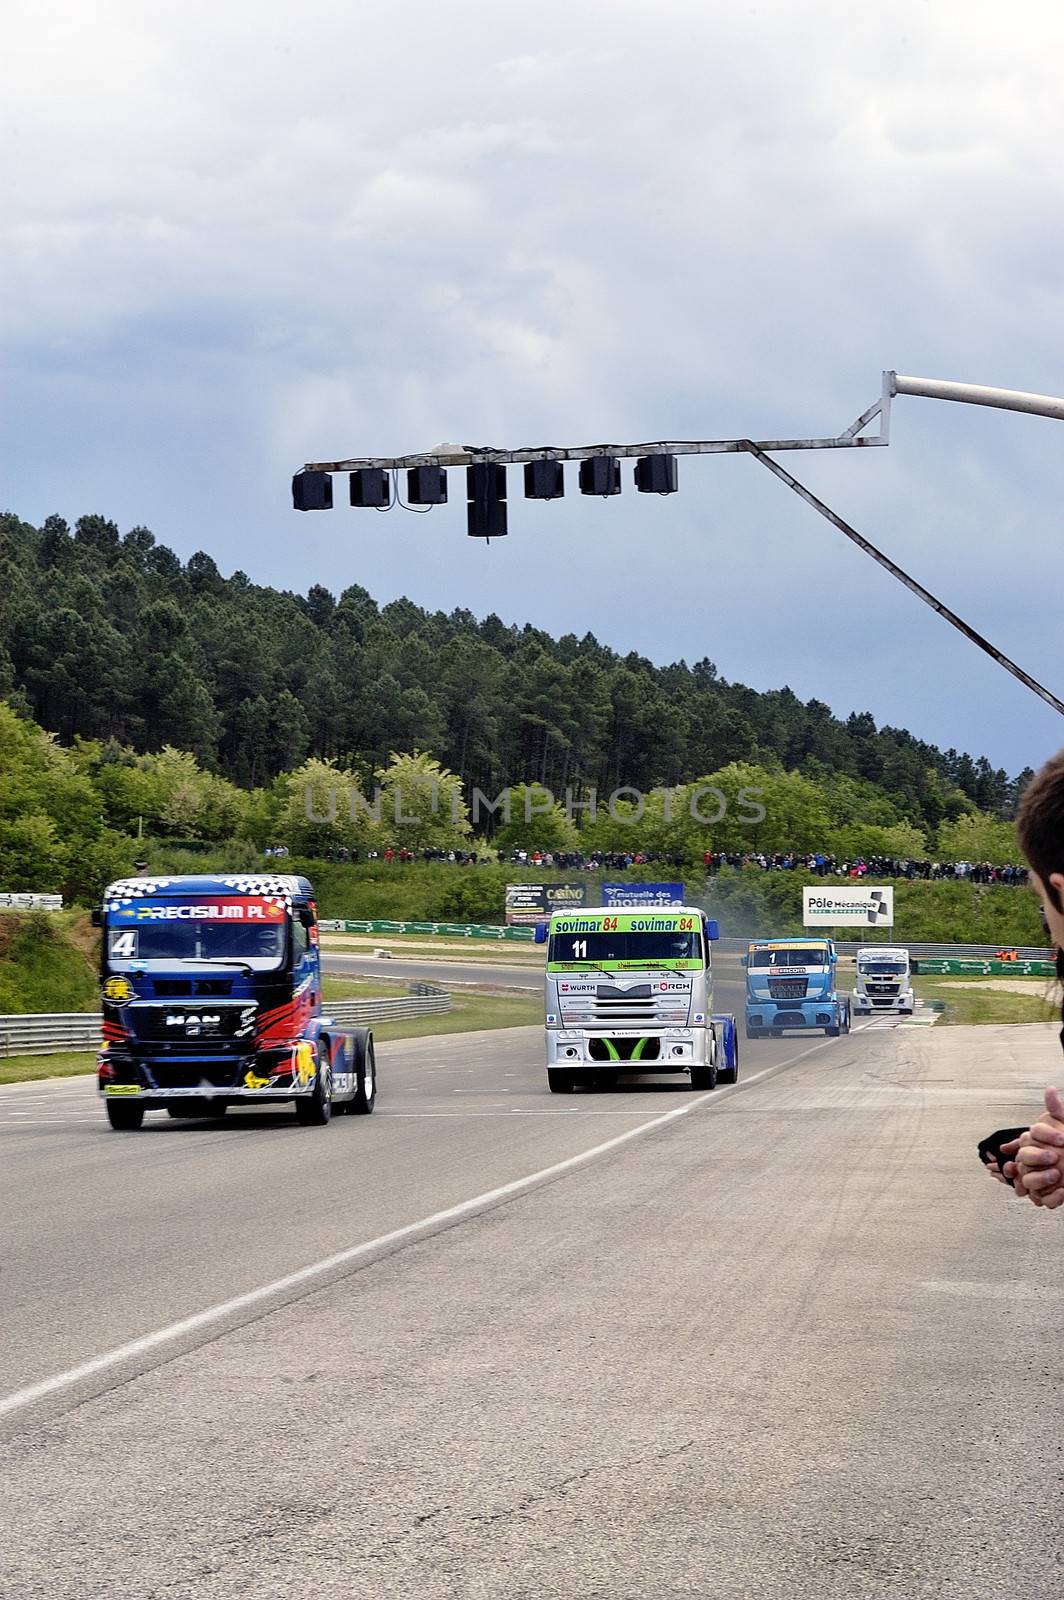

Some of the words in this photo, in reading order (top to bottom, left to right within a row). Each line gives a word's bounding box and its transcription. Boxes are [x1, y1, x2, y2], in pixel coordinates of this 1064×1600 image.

[546, 886, 584, 899] CASINO
[808, 898, 833, 908] Pôle
[835, 901, 877, 909] Mécanique
[136, 905, 244, 920] PRECISIUM
[247, 905, 266, 918] PL
[555, 919, 602, 932] sovimar
[603, 917, 618, 931] 84
[631, 917, 678, 931] sovimar
[679, 918, 693, 931] 84
[111, 932, 136, 956] 4
[572, 940, 587, 958] 11
[675, 960, 689, 969] shell
[769, 952, 776, 964] 1
[166, 1015, 221, 1026] MAN
